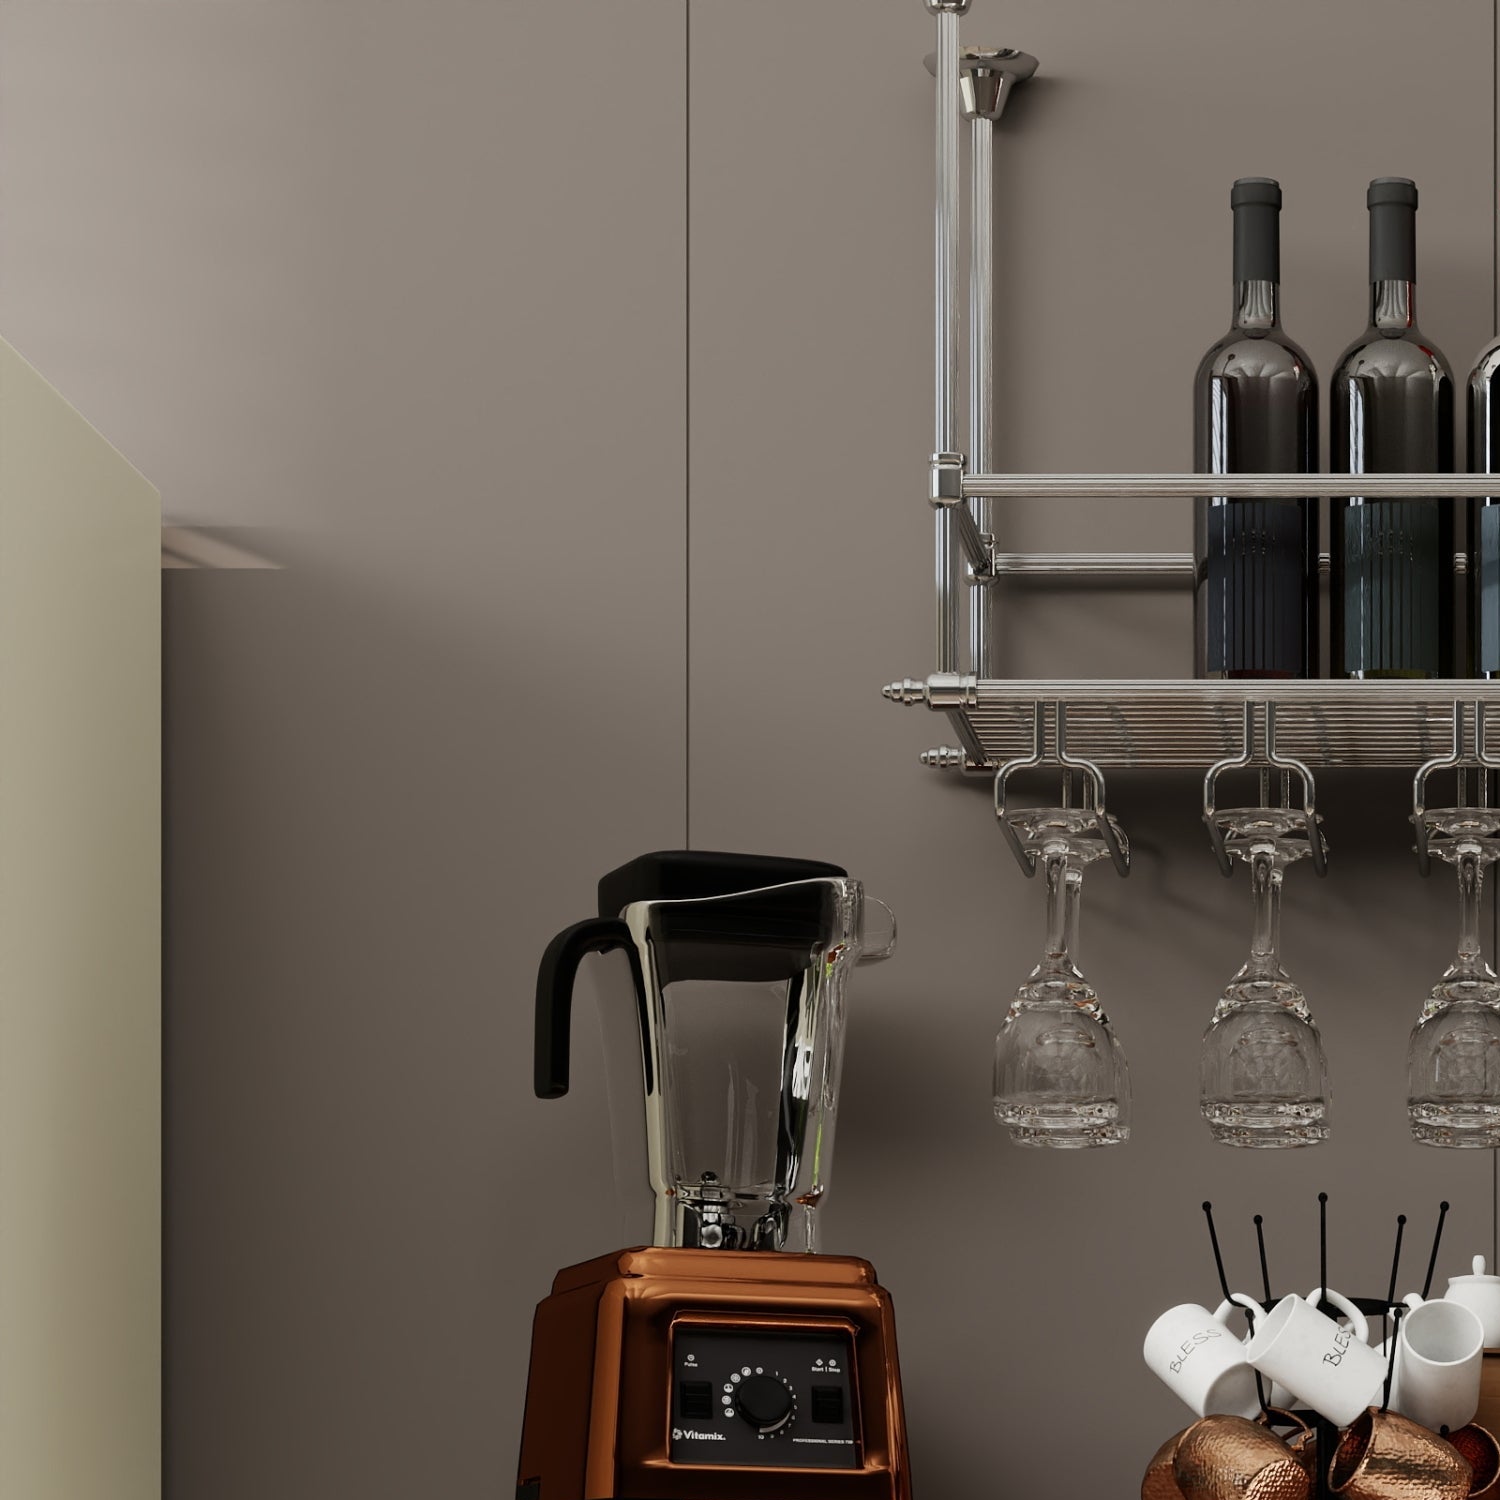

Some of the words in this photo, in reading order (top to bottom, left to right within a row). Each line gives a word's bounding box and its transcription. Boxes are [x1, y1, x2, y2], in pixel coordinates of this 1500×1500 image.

[1170, 1329, 1222, 1373] BLESS
[1323, 1327, 1351, 1367] BLES
[683, 1430, 723, 1440] Vitamix
